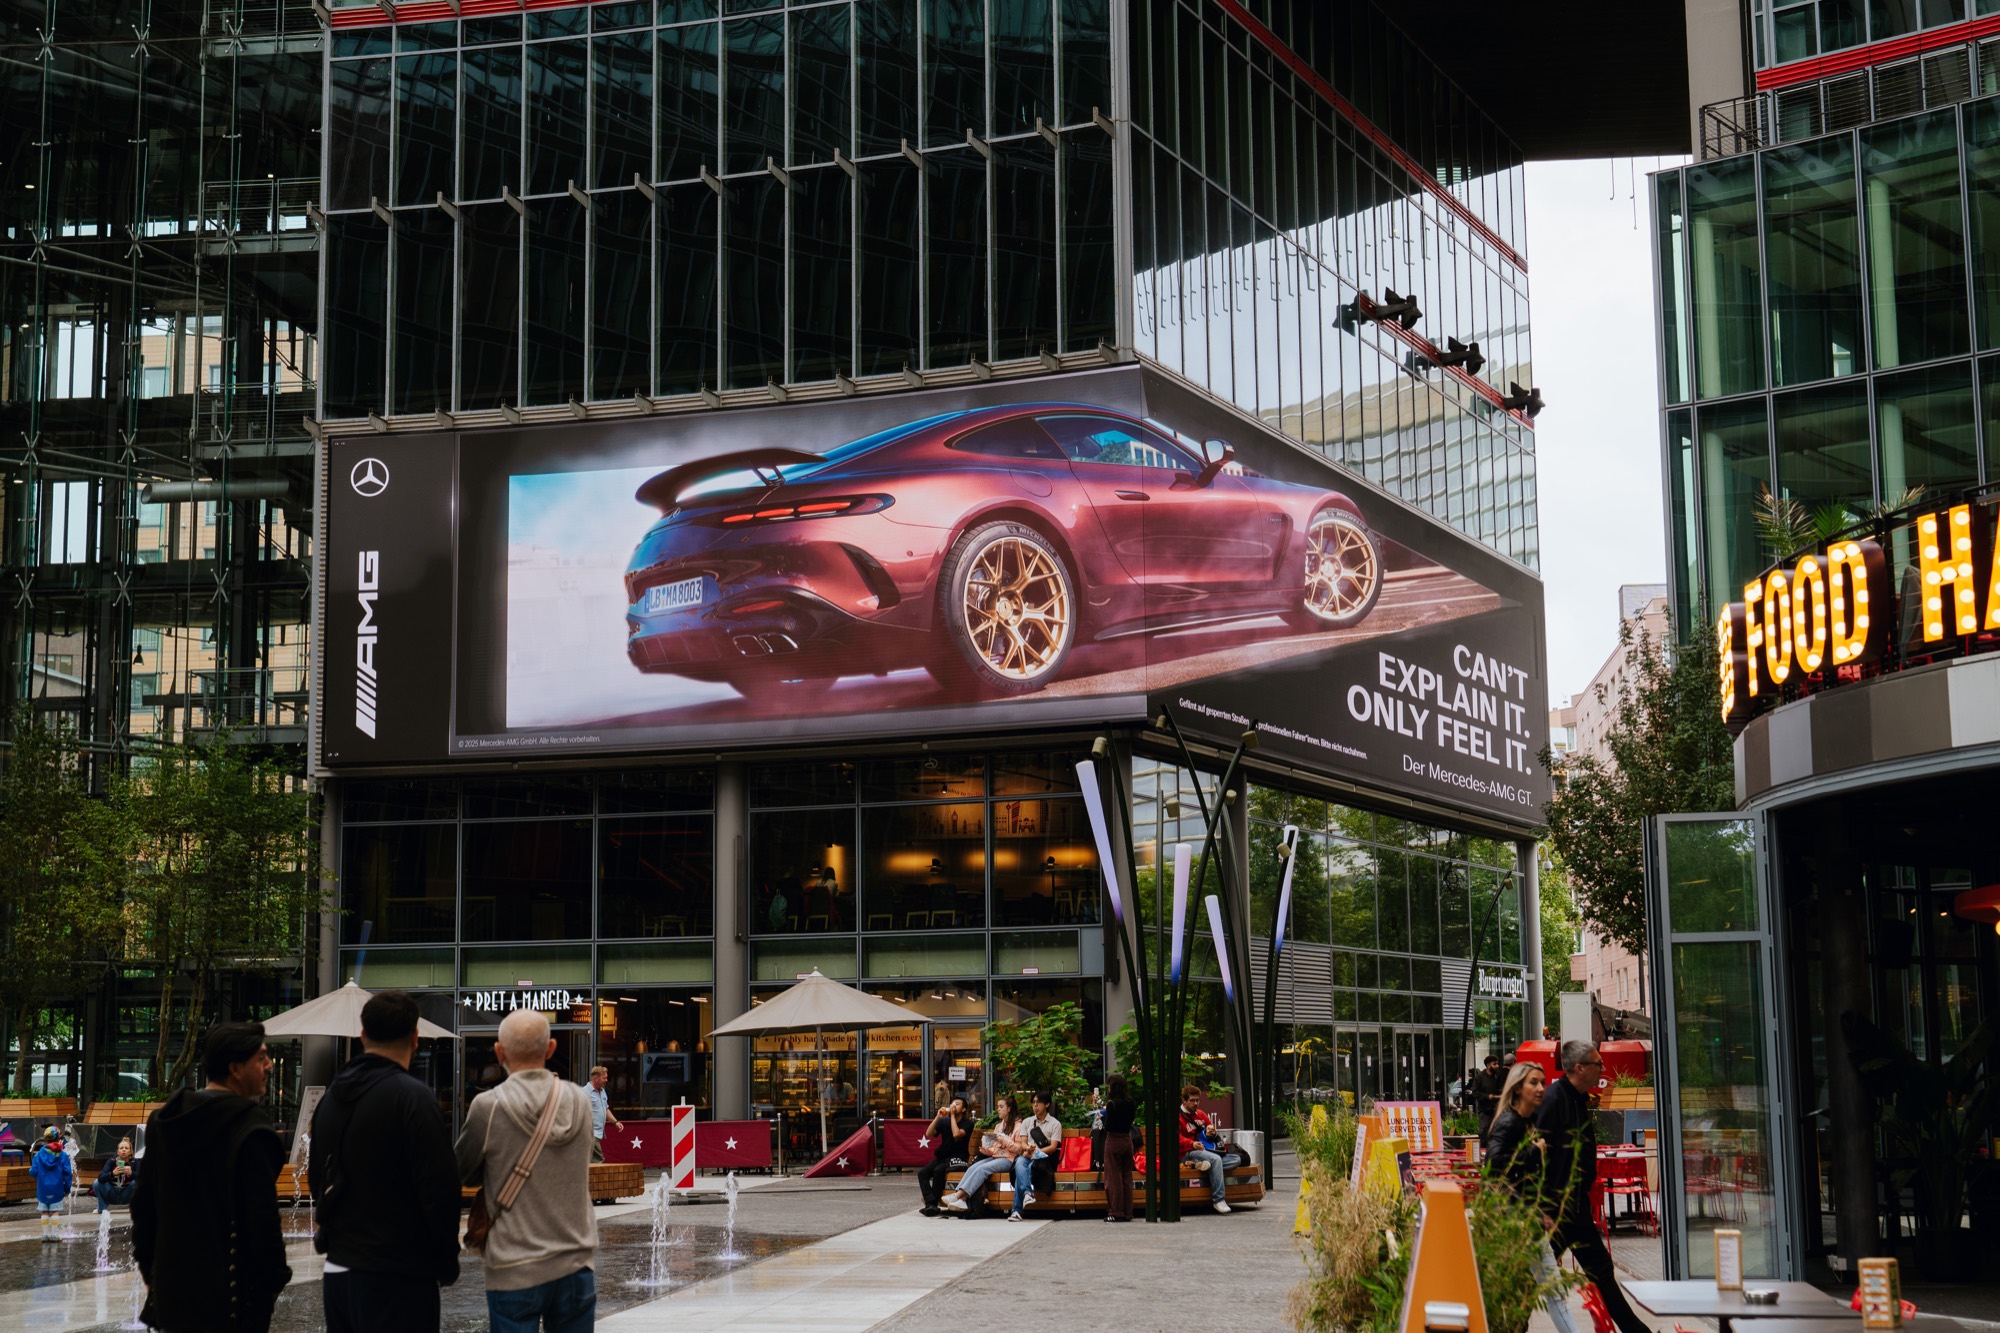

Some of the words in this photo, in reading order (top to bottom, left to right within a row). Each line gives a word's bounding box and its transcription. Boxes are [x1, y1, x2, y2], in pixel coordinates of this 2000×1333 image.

[1336, 511, 1367, 529] MICHELIN
[1020, 527, 1056, 554] MICHELIN
[357, 551, 379, 680] AMG
[1744, 540, 1870, 697] FOOD
[1453, 644, 1528, 700] CAN'T
[1379, 651, 1498, 727] EXPLAIN
[1504, 700, 1531, 739] IT.
[465, 740, 478, 748] 2025
[1179, 698, 1197, 711] Gefilmt
[1198, 704, 1206, 713] auf
[1206, 707, 1232, 718] gesperrten
[1258, 722, 1292, 738] professionellen
[1321, 738, 1332, 750] Bitte
[1332, 743, 1343, 753] nicht
[1347, 684, 1430, 741] ONLY
[1437, 713, 1500, 766] FEEL
[1505, 738, 1532, 776] IT.
[1403, 754, 1425, 776] Der
[1429, 762, 1515, 802] Mercedes-AMG
[1517, 789, 1534, 807] GT.
[476, 991, 506, 1011] PRET
[509, 992, 518, 1011] A
[522, 990, 571, 1010] MANGER
[871, 1033, 900, 1042] kitchen
[1386, 1117, 1410, 1125] LUNCH
[1411, 1117, 1433, 1125] DEALS
[1389, 1125, 1417, 1133] SERVED
[1418, 1125, 1431, 1133] HOT
